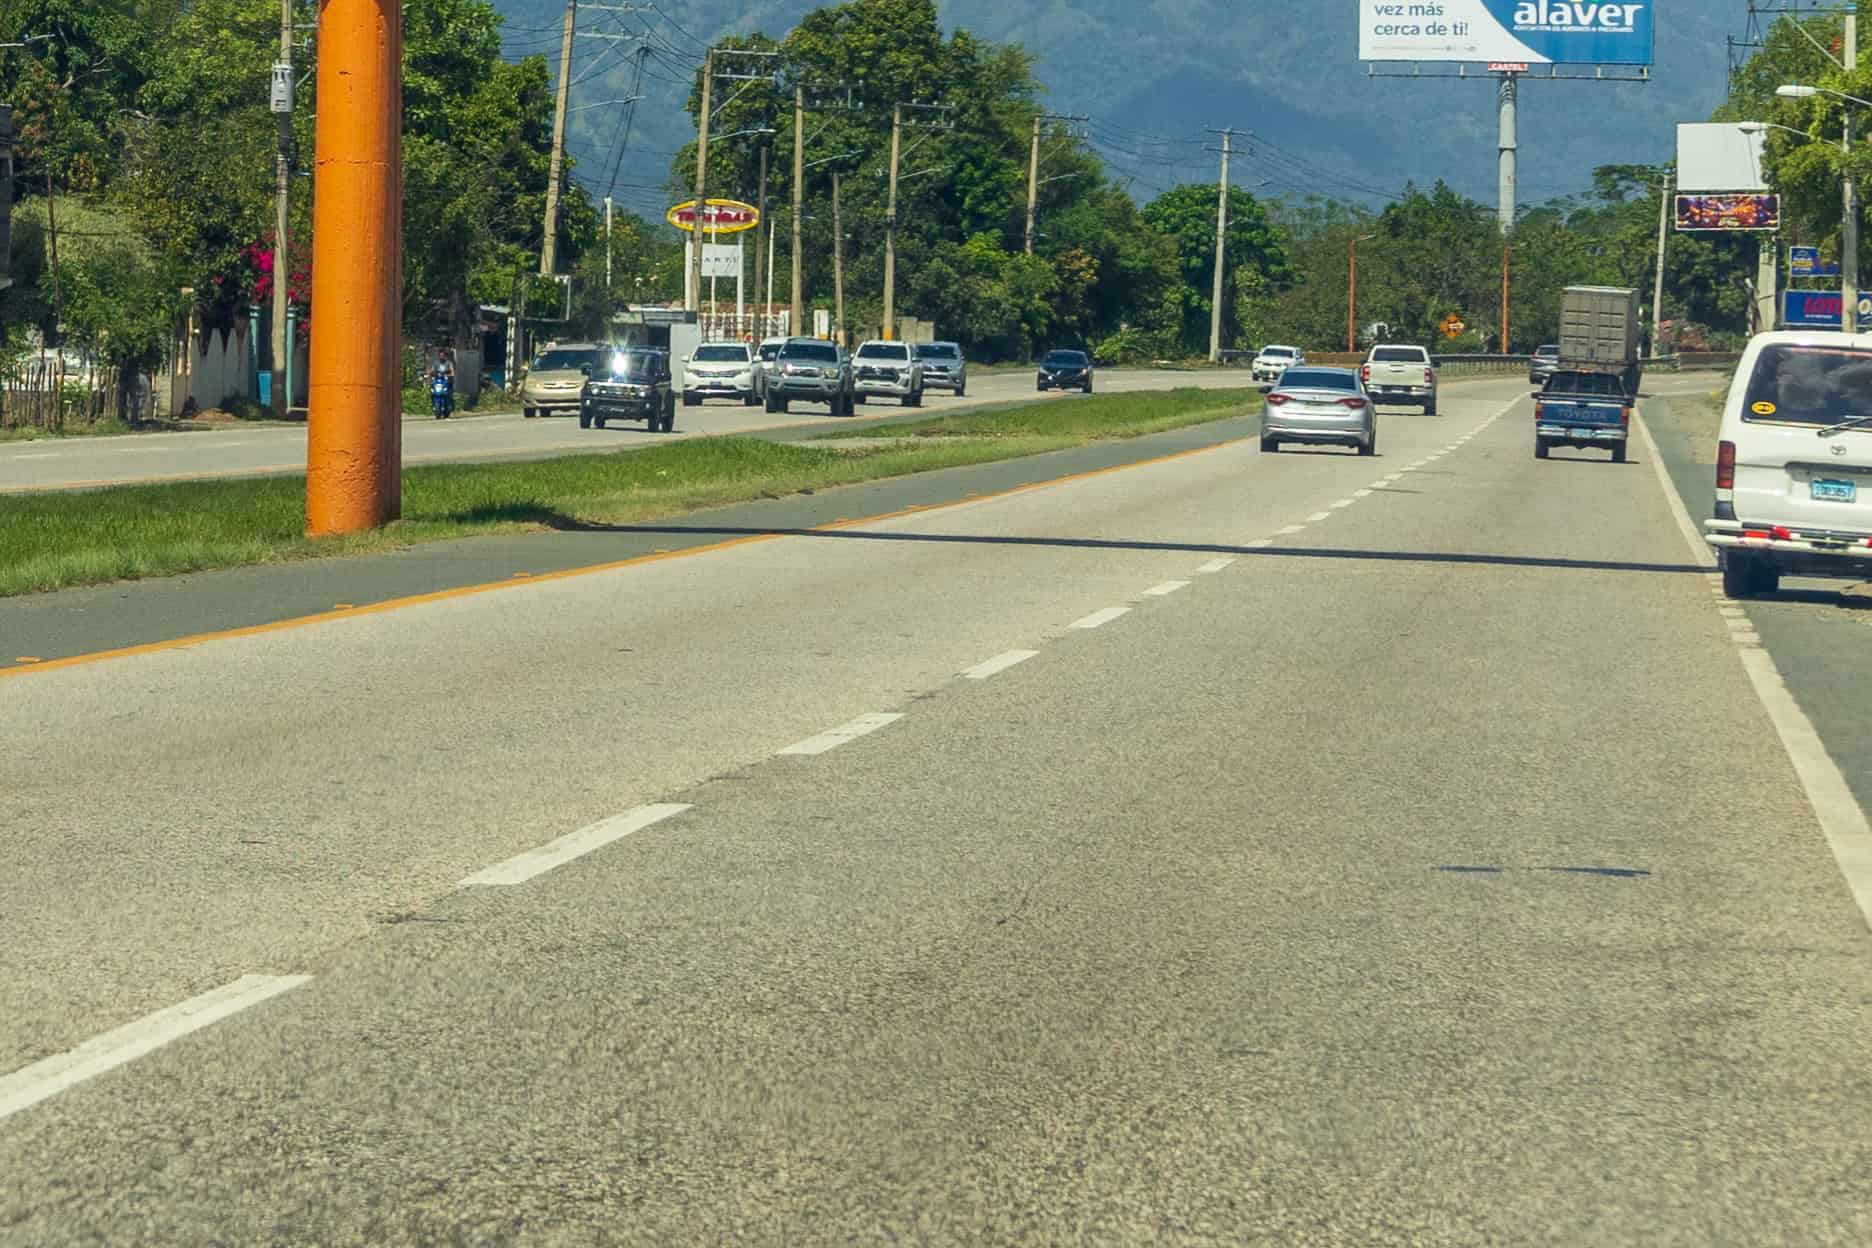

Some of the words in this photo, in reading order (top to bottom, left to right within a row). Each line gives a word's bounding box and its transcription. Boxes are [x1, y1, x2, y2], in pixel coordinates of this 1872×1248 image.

[1374, 4, 1404, 16] vez
[1408, 1, 1445, 16] más
[1374, 23, 1421, 36] cerca
[1425, 21, 1448, 36] de
[1452, 22, 1469, 36] ti!
